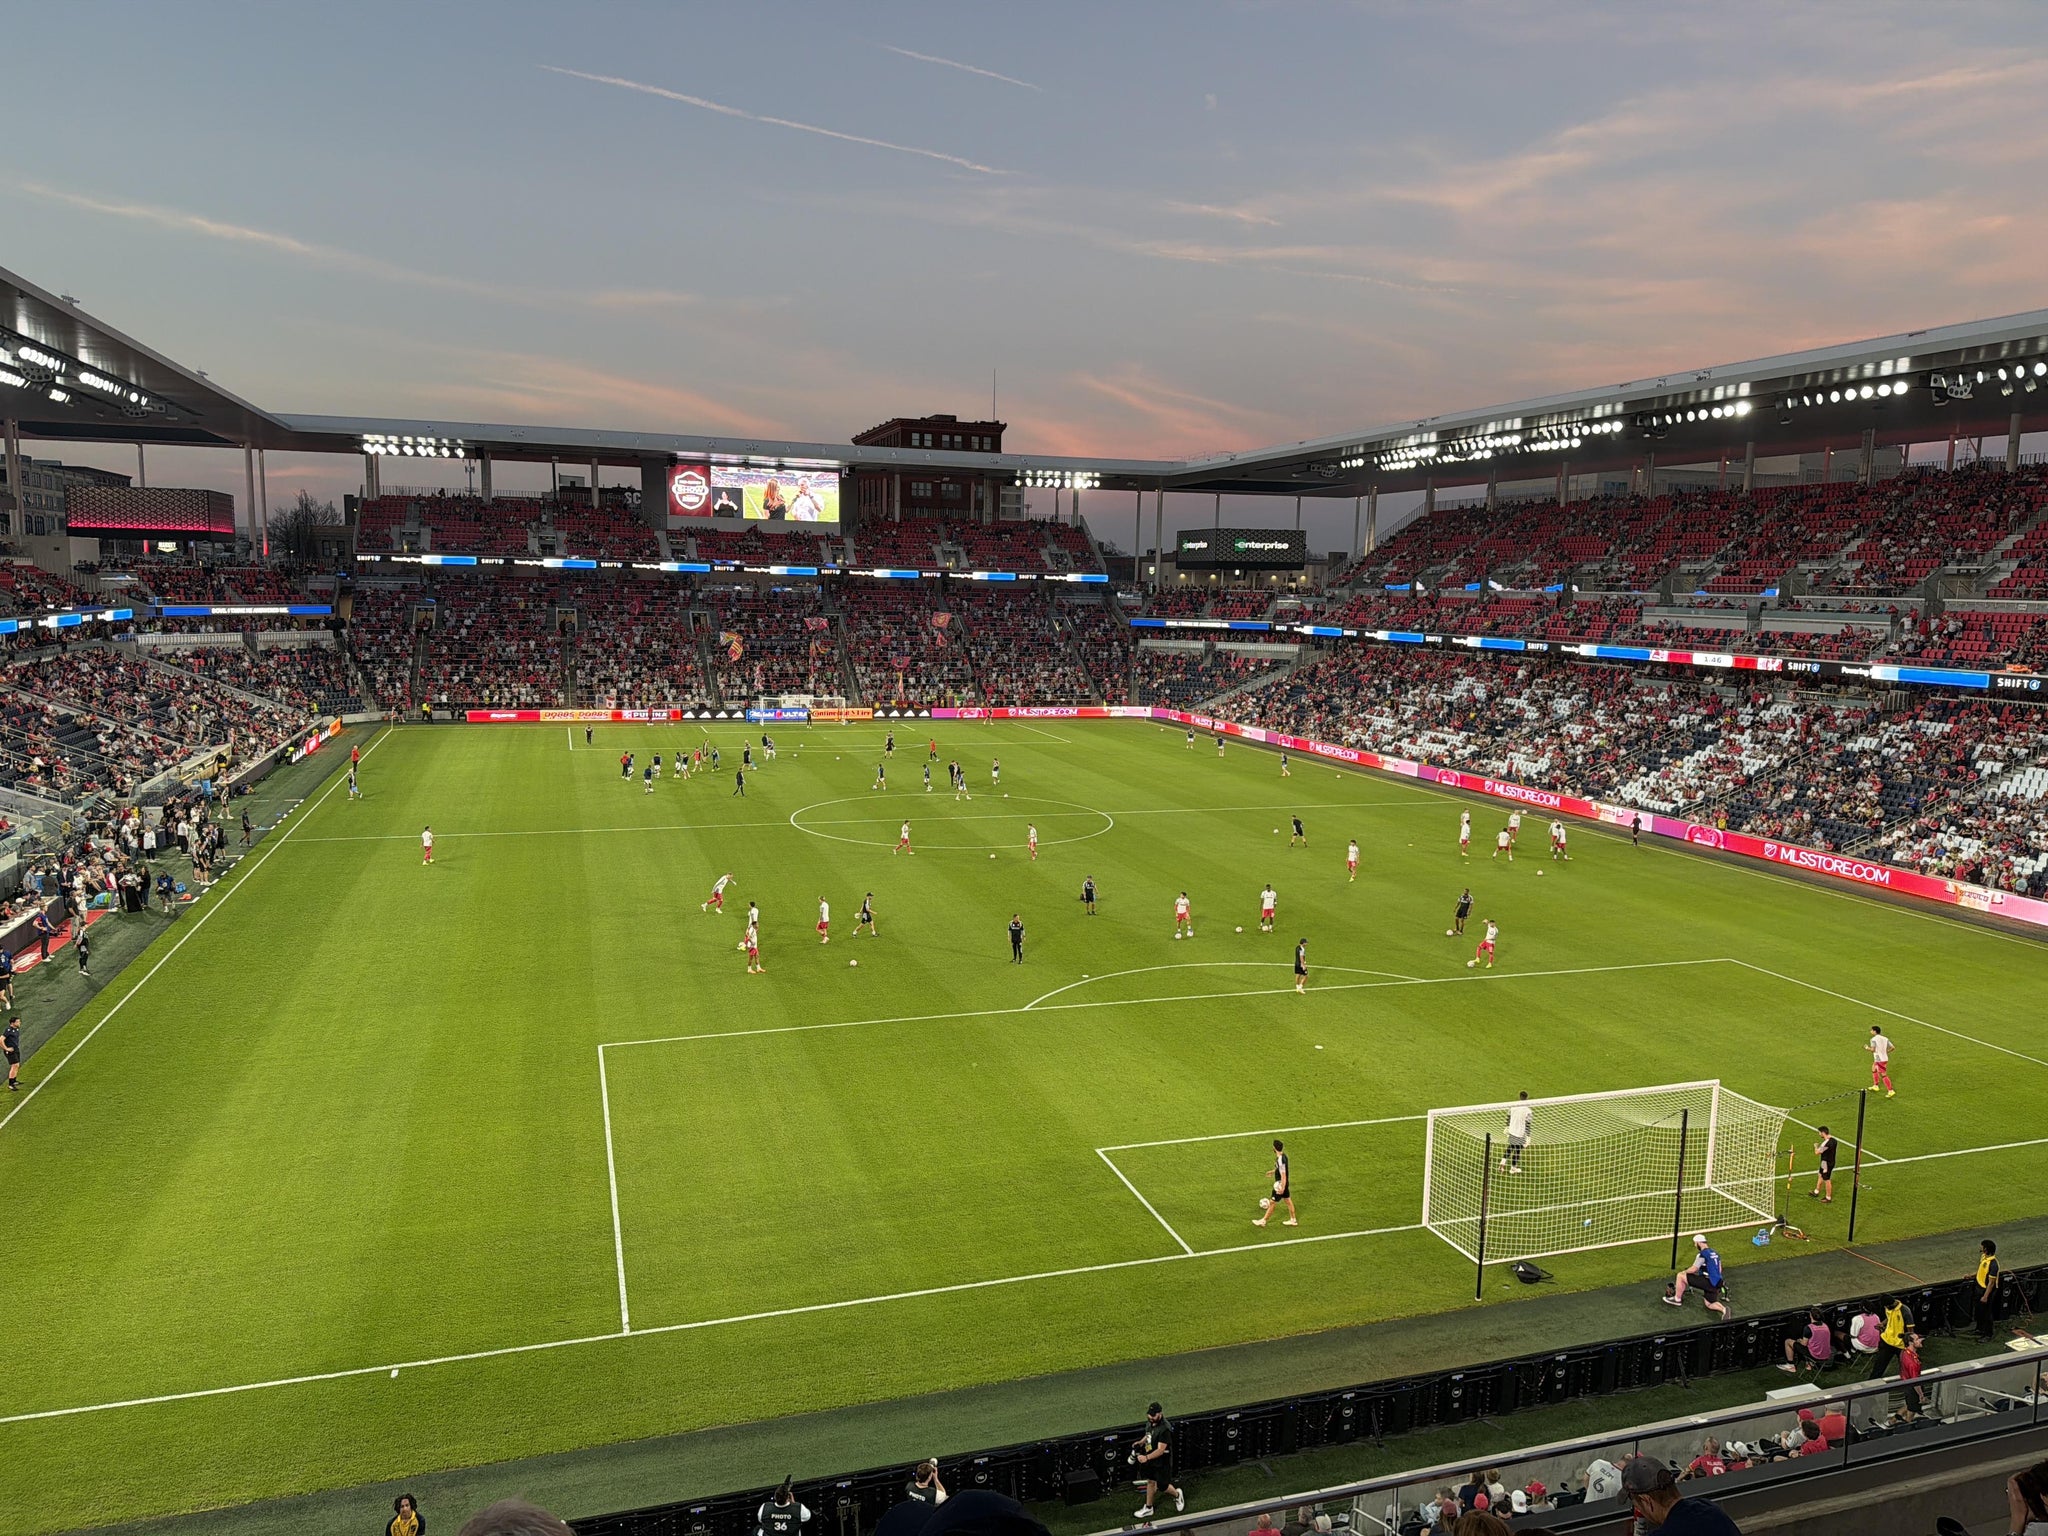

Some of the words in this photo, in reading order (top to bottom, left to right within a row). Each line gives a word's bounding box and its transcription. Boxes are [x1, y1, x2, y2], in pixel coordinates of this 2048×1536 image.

[1236, 540, 1290, 550] enterprise
[1592, 1476, 1605, 1493] 6
[908, 1490, 926, 1502] PHOTO
[774, 1522, 788, 1531] 36
